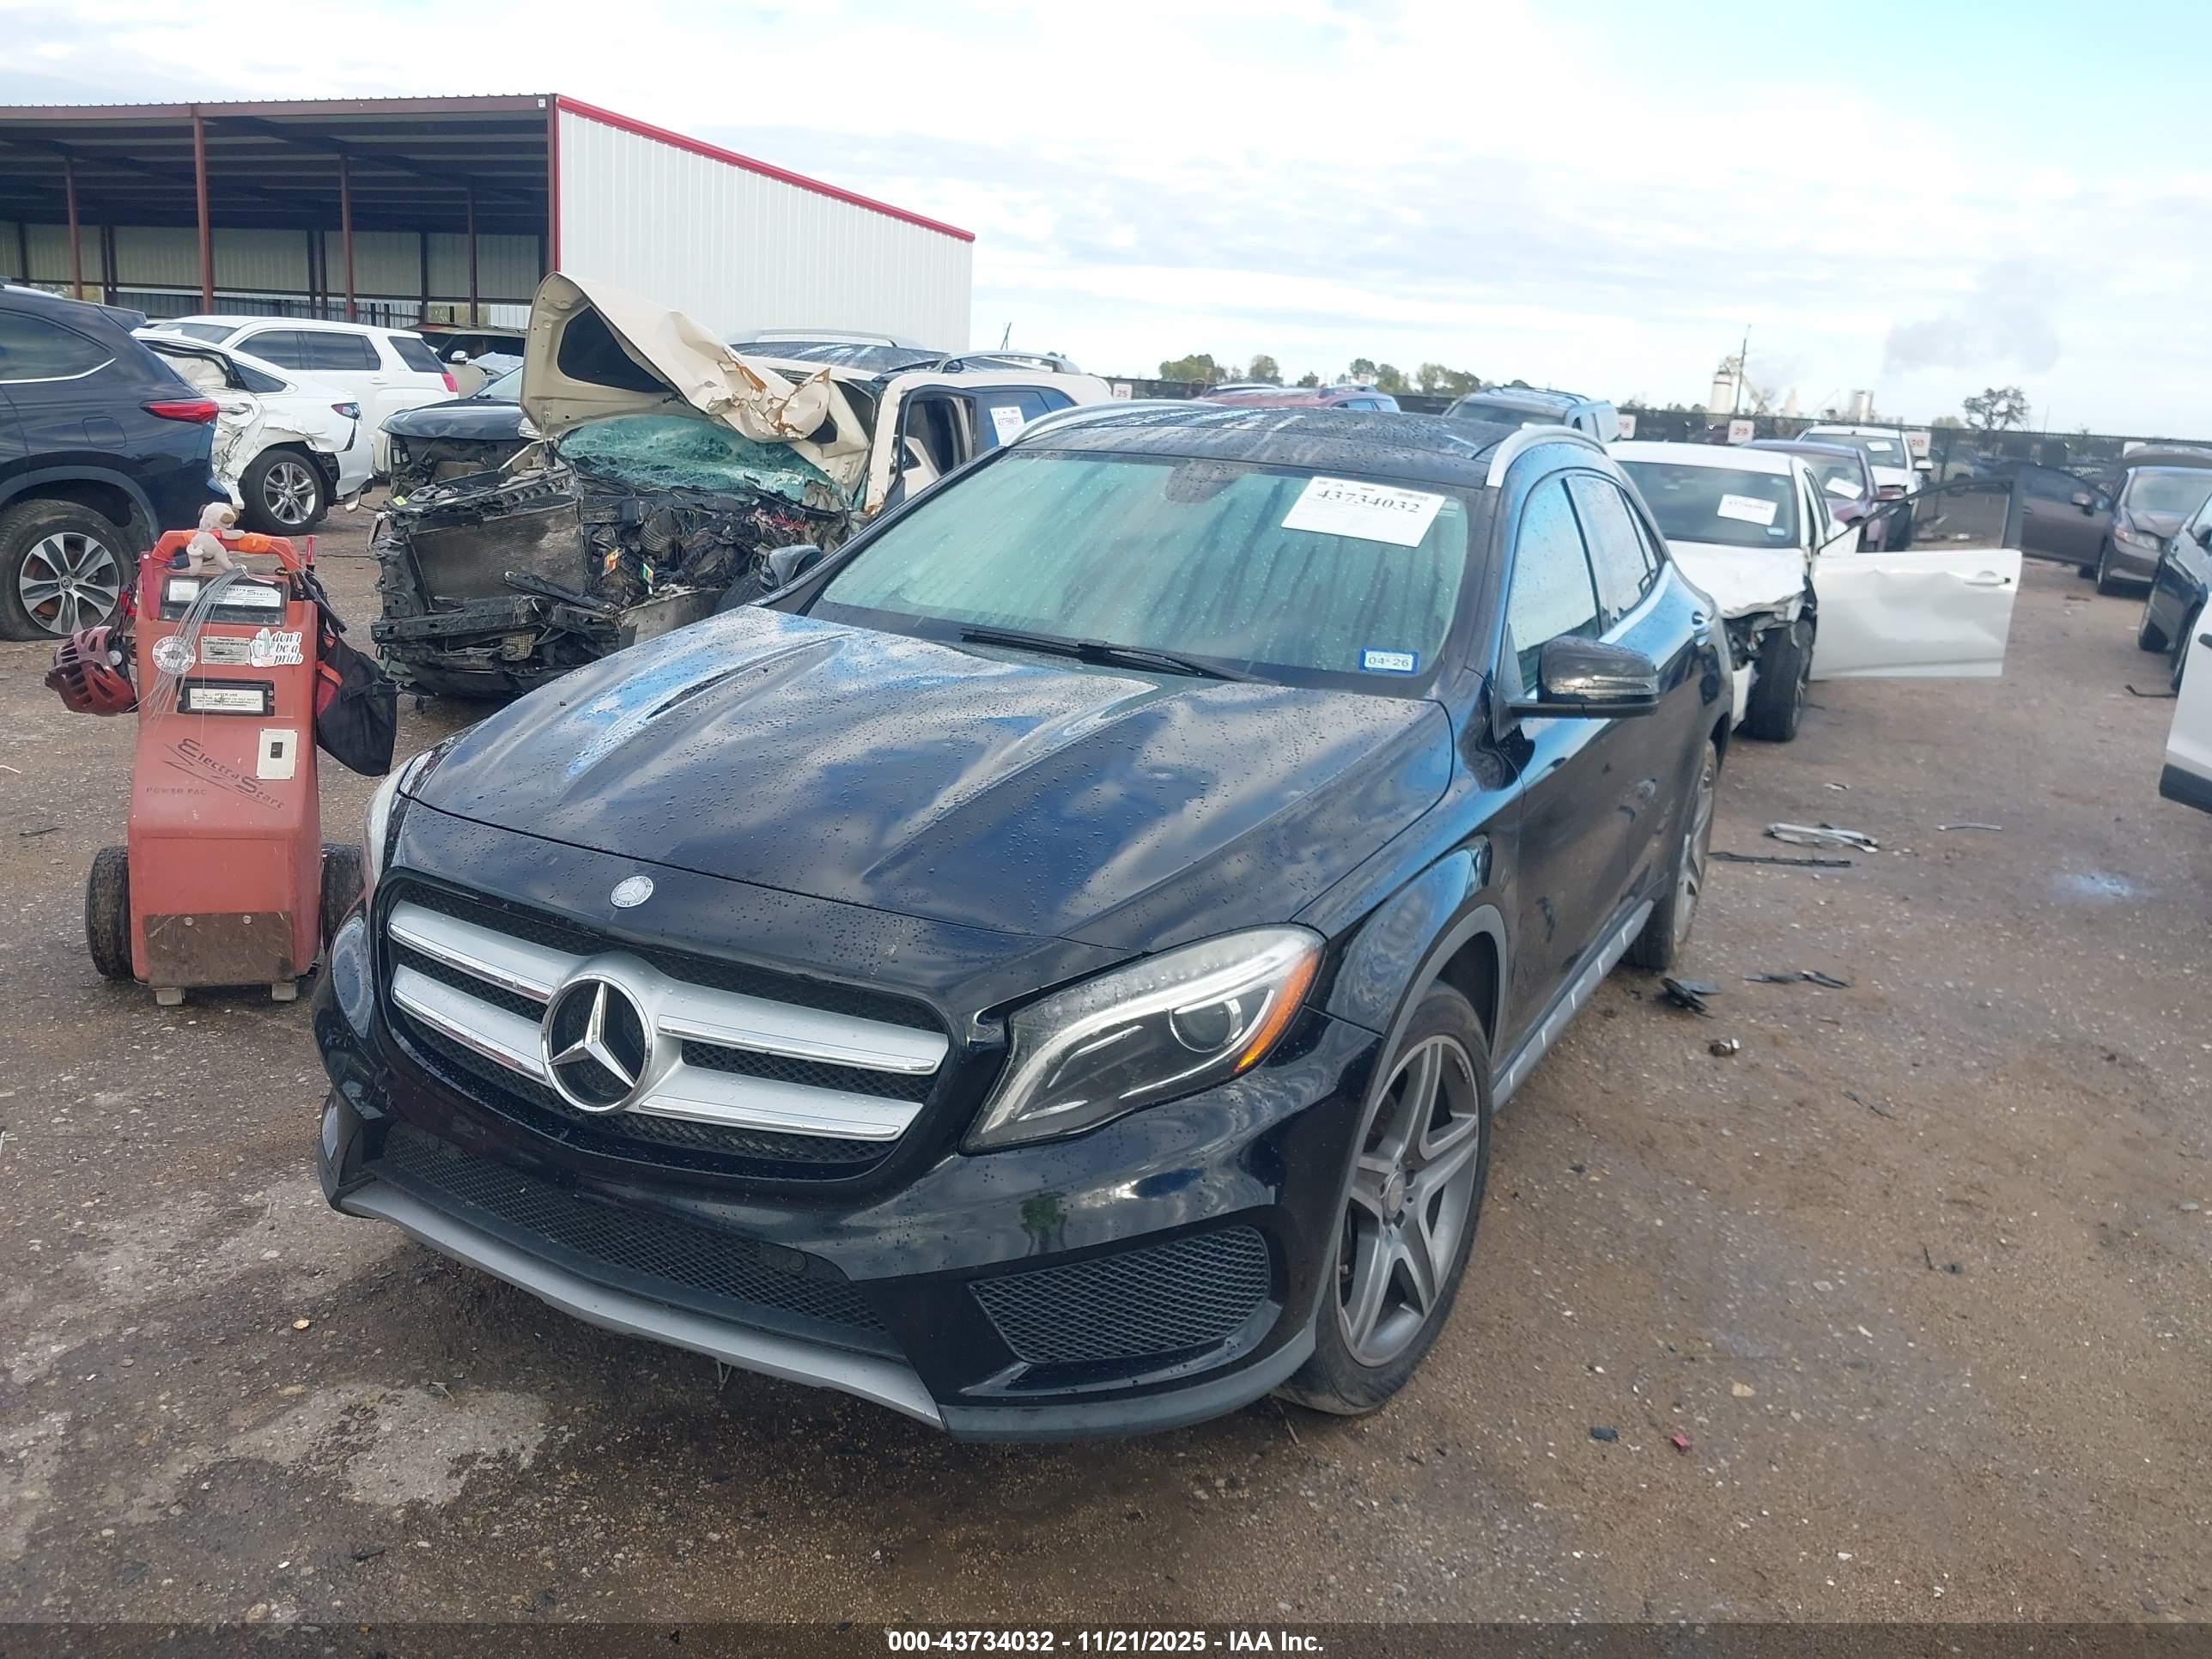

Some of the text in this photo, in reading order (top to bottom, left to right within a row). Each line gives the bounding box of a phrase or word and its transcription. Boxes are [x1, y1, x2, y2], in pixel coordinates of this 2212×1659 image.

[1317, 489, 1420, 514] 43734032
[272, 632, 301, 642] don't
[276, 643, 299, 653] be a
[274, 653, 301, 665] prick
[177, 738, 285, 809] Electra Start
[146, 786, 184, 794] POWER
